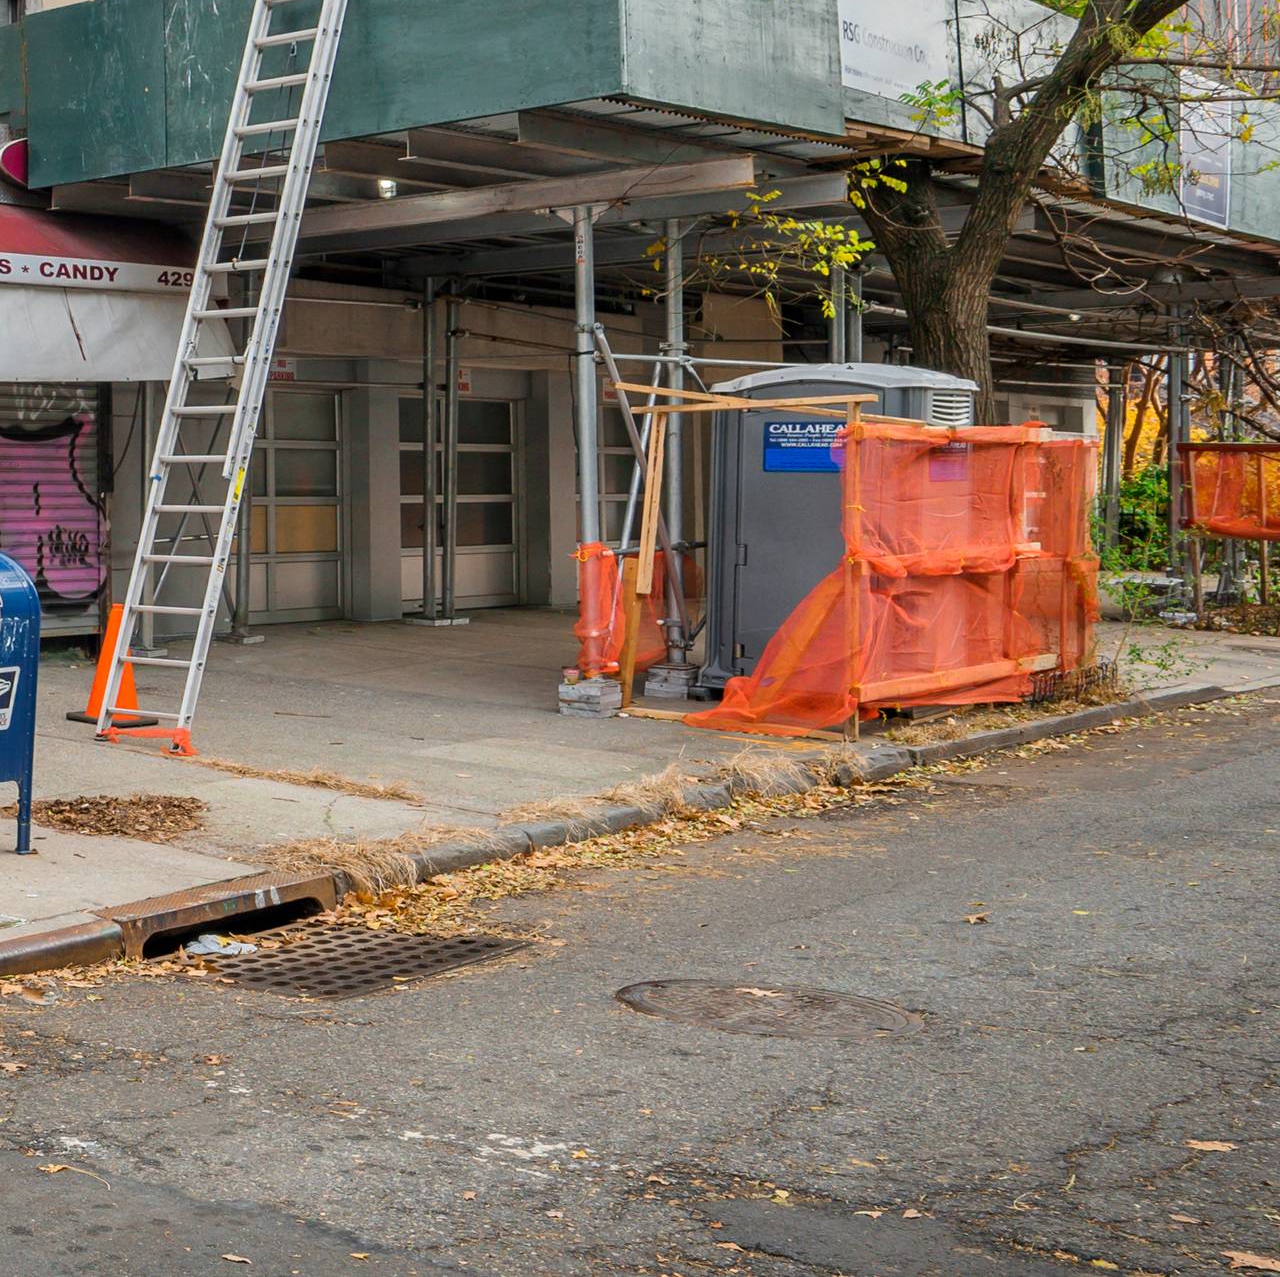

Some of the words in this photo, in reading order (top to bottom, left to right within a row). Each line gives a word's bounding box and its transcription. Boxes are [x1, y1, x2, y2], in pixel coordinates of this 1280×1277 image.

[842, 20, 861, 43] RSG
[39, 262, 120, 283] CANDY
[157, 271, 194, 288] 429
